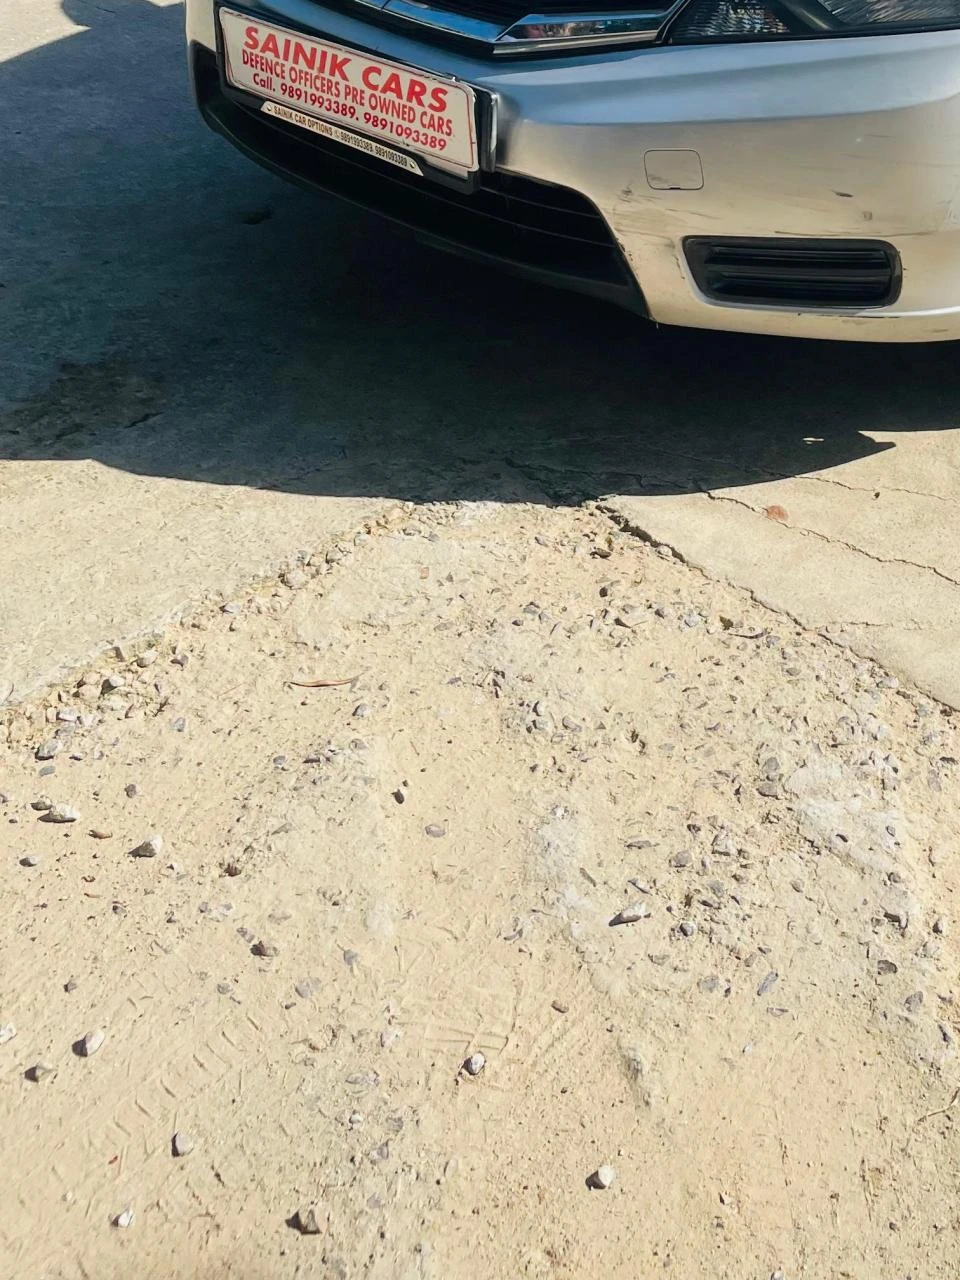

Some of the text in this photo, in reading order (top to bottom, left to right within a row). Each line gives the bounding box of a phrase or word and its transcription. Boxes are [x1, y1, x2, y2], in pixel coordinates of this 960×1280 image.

[242, 48, 453, 137] DEFENCE OFFICERS PRE OWNED CARS
[244, 26, 449, 113] SAINIK CARS
[253, 73, 276, 92] Call.
[363, 112, 447, 151] 9891093389
[273, 106, 294, 121] SAINIK
[295, 114, 307, 126] CAR
[307, 118, 333, 137] OPTIONS
[374, 145, 408, 167] 9891093389
